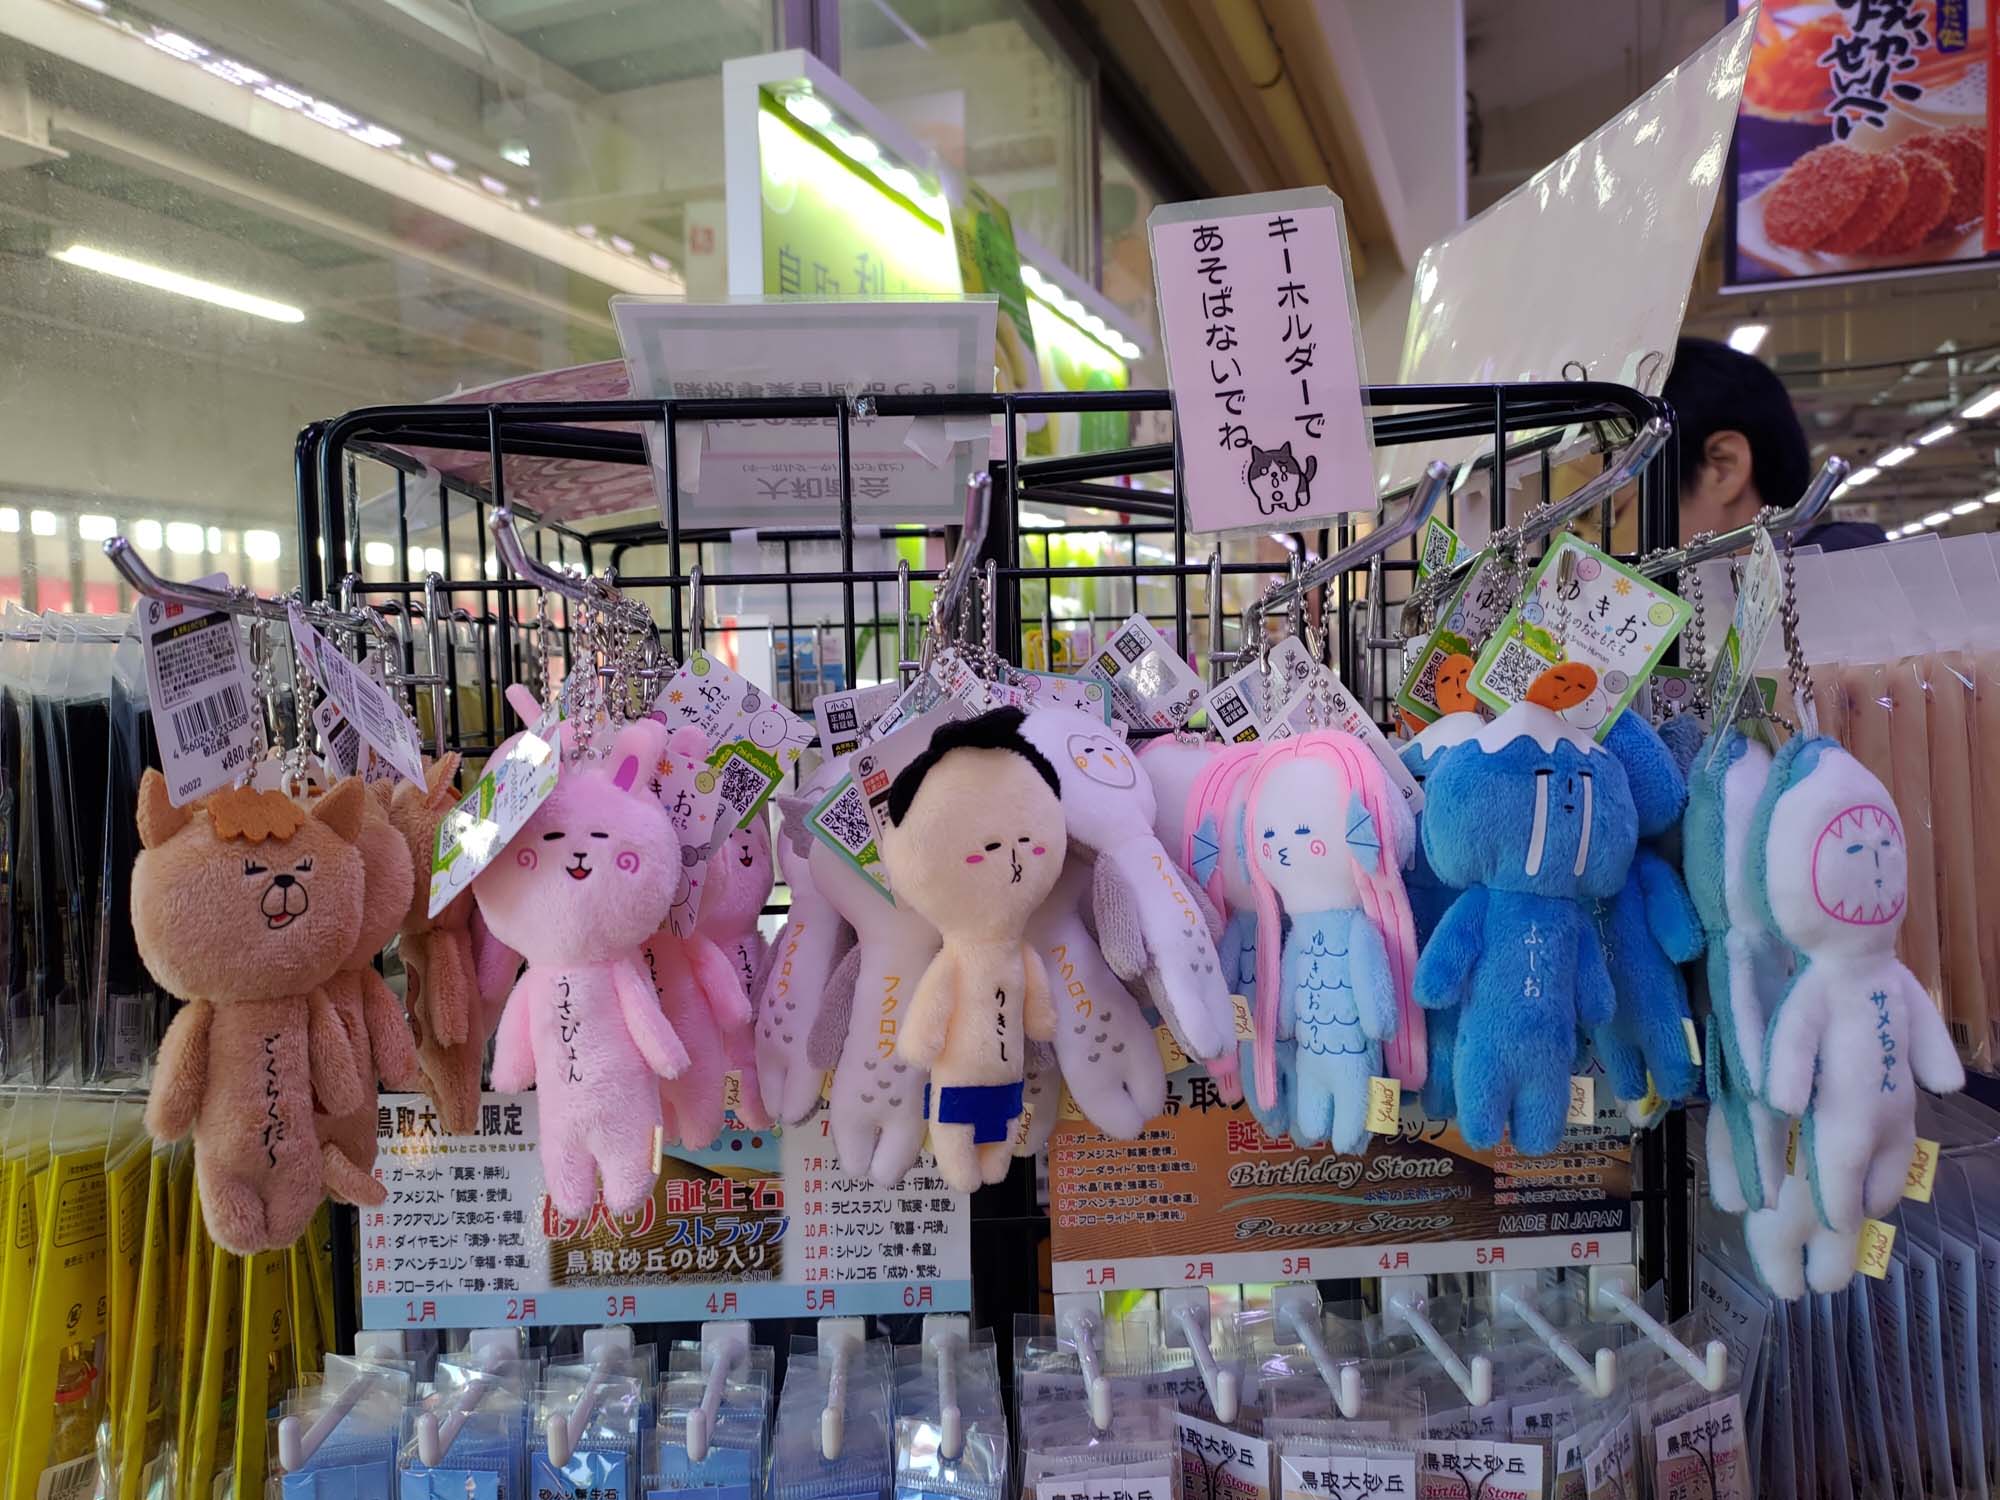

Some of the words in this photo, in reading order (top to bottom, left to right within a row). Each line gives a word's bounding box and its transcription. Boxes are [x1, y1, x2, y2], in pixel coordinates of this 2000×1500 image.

[1192, 225, 1253, 451] あそばないでね
[1268, 215, 1325, 439] キーホルダーで
[179, 777, 202, 797] 00022
[1152, 854, 1197, 926] フクロウ
[774, 922, 805, 997] フクロウ
[1523, 924, 1543, 998] ふじお
[1050, 943, 1094, 1019] フクロウ
[558, 975, 583, 1083] うさぴょん
[876, 975, 901, 1058] フクロウ
[994, 987, 1009, 1062] りきし
[1869, 990, 1897, 1092] サメちゃん
[376, 1103, 523, 1138] 鳥取大限定
[374, 1166, 510, 1182] 月：ガーネット「真実・勝利」
[1230, 1153, 1363, 1188] Birthday
[1366, 1154, 1454, 1181] Stone
[665, 1177, 785, 1215] 誕生石
[665, 1215, 791, 1248] ストラップ
[1235, 1211, 1352, 1240] Power
[1355, 1211, 1454, 1233] Stone
[1499, 1214, 1547, 1233] MADE
[1551, 1212, 1569, 1230] IN
[1569, 1209, 1623, 1229] JAPAN
[566, 1246, 765, 1275] 鳥取砂丘の砂入り
[1086, 1267, 1116, 1285] 1月
[1184, 1262, 1214, 1280] 2月
[1281, 1257, 1311, 1275] 3月
[1379, 1252, 1409, 1270] 4月
[1476, 1246, 1505, 1264] 5月
[1570, 1241, 1600, 1259] 6月
[406, 1301, 437, 1322] 1月
[506, 1299, 537, 1320] 2月
[606, 1296, 637, 1317] 3月
[705, 1291, 738, 1313] 4月
[806, 1288, 835, 1310] 5月
[903, 1286, 933, 1307] 6月
[1299, 1470, 1404, 1493] 鳥取大砂丘
[1422, 1453, 1526, 1475] 鳥取大砂丘
